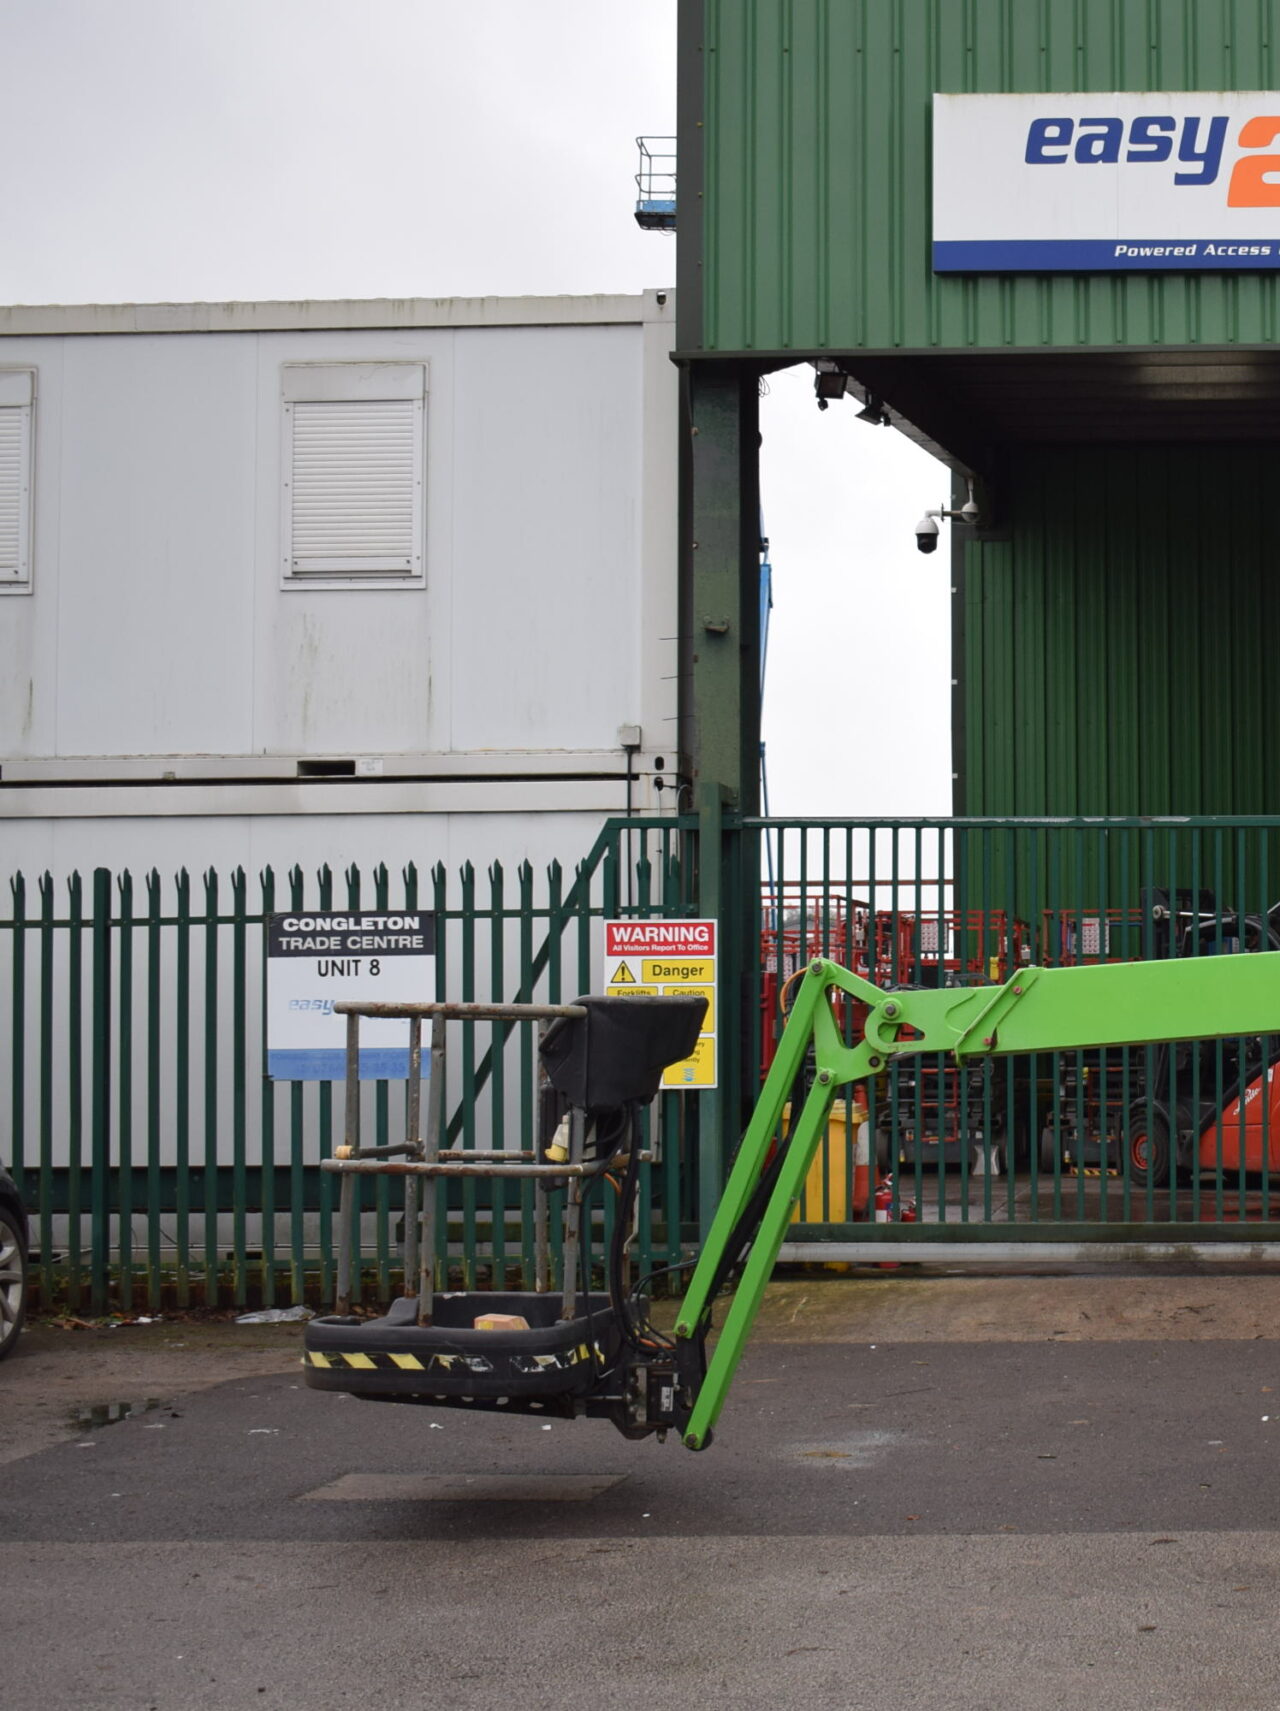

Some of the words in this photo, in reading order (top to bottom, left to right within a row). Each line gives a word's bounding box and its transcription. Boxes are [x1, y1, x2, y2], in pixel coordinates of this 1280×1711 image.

[1115, 244, 1196, 257] Powered
[1203, 244, 1271, 256] Access
[283, 917, 420, 931] CONGLETON
[612, 926, 709, 942] WARNING
[279, 936, 342, 950] TRADE
[347, 935, 424, 949] CENTRE
[624, 944, 650, 952] Visitors
[651, 944, 676, 952] Report
[687, 943, 709, 951] Office
[317, 959, 361, 977] UNIT
[369, 959, 381, 976] 8
[652, 964, 705, 979] Danger
